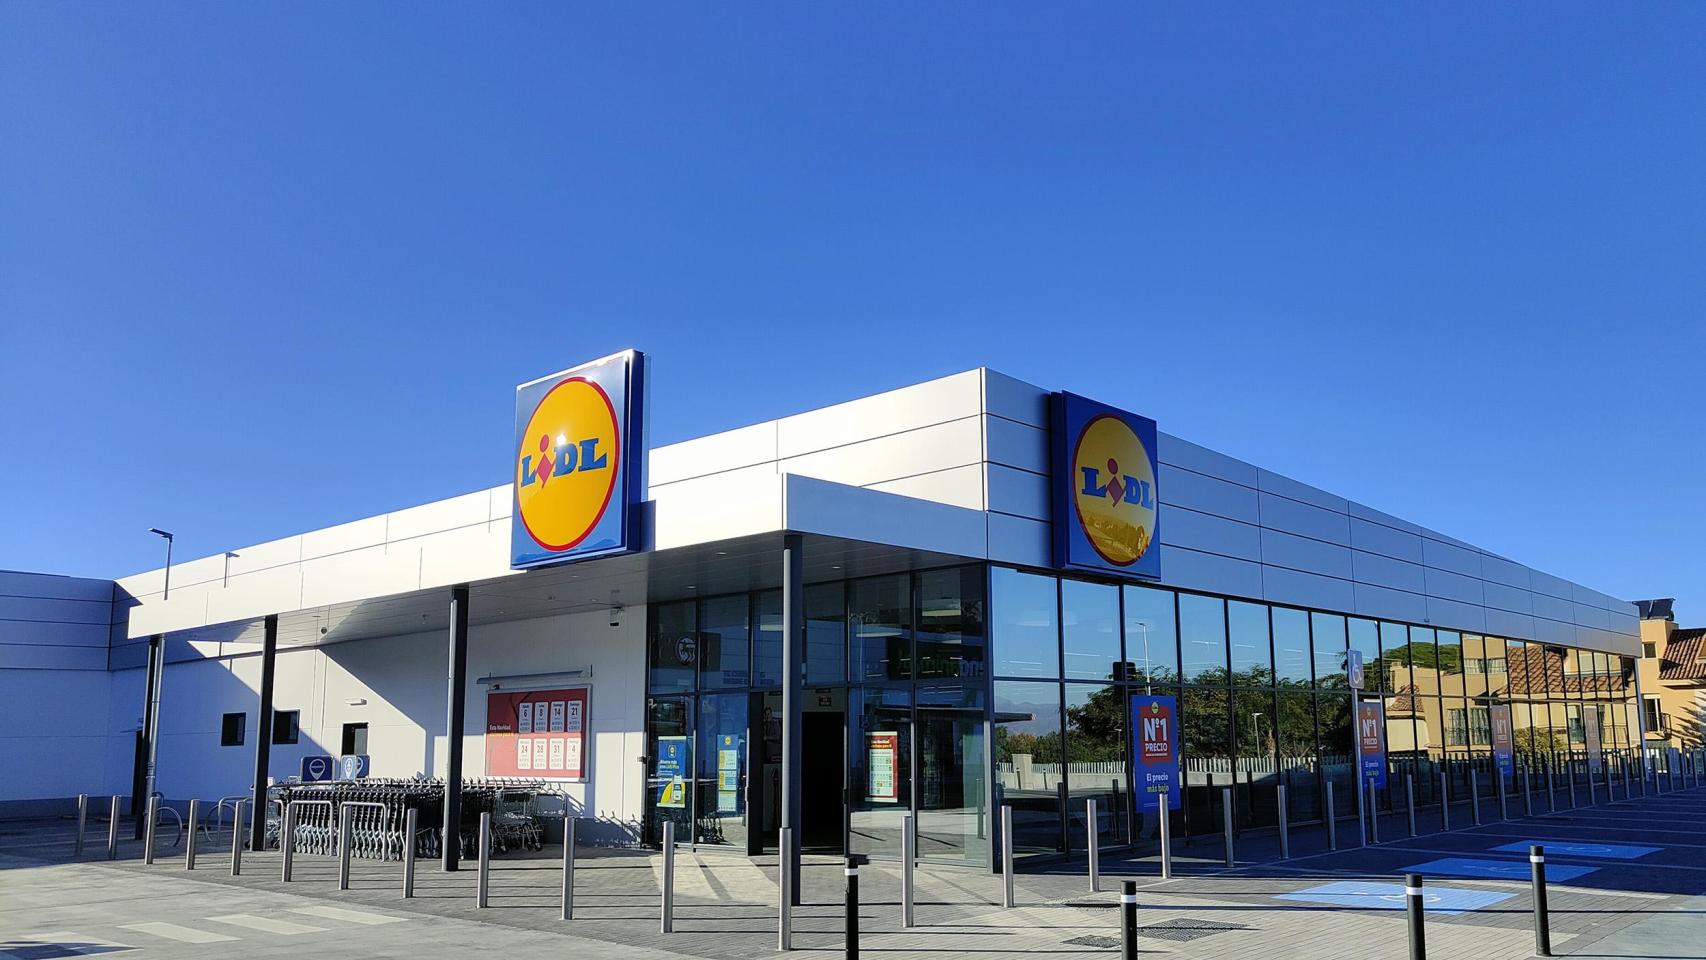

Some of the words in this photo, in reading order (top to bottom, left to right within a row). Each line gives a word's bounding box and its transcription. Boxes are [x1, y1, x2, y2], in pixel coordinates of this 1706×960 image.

[554, 708, 561, 716] 14
[571, 707, 578, 716] 21
[1145, 743, 1168, 752] PRECIO
[1146, 773, 1152, 782] El
[1152, 772, 1169, 783] precio
